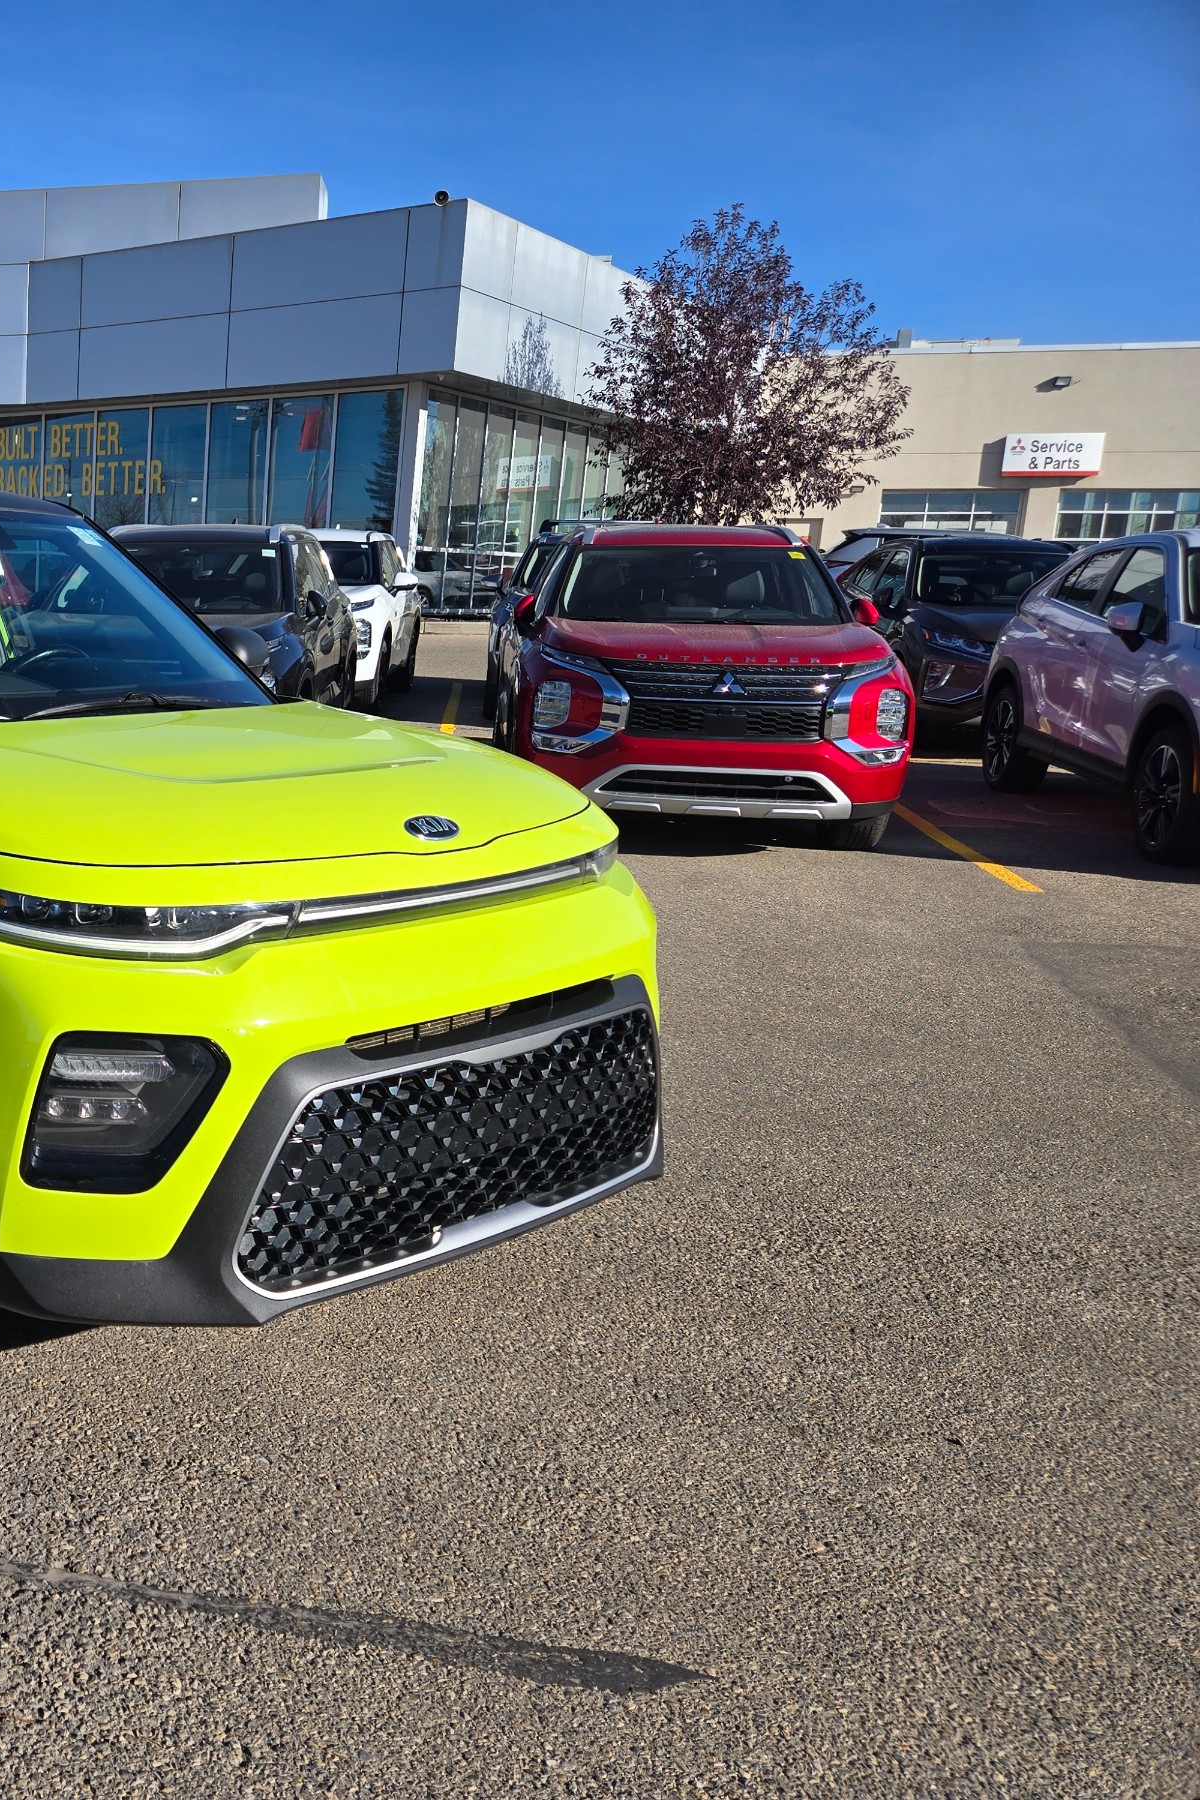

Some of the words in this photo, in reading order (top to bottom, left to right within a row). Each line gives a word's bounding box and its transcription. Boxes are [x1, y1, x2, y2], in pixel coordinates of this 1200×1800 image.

[50, 421, 124, 458] BETTER.
[1030, 440, 1083, 453] Service
[1028, 457, 1039, 470] &
[1043, 457, 1080, 470] Parts
[81, 459, 166, 497] BETTER.
[636, 653, 821, 664] OUTLANDER
